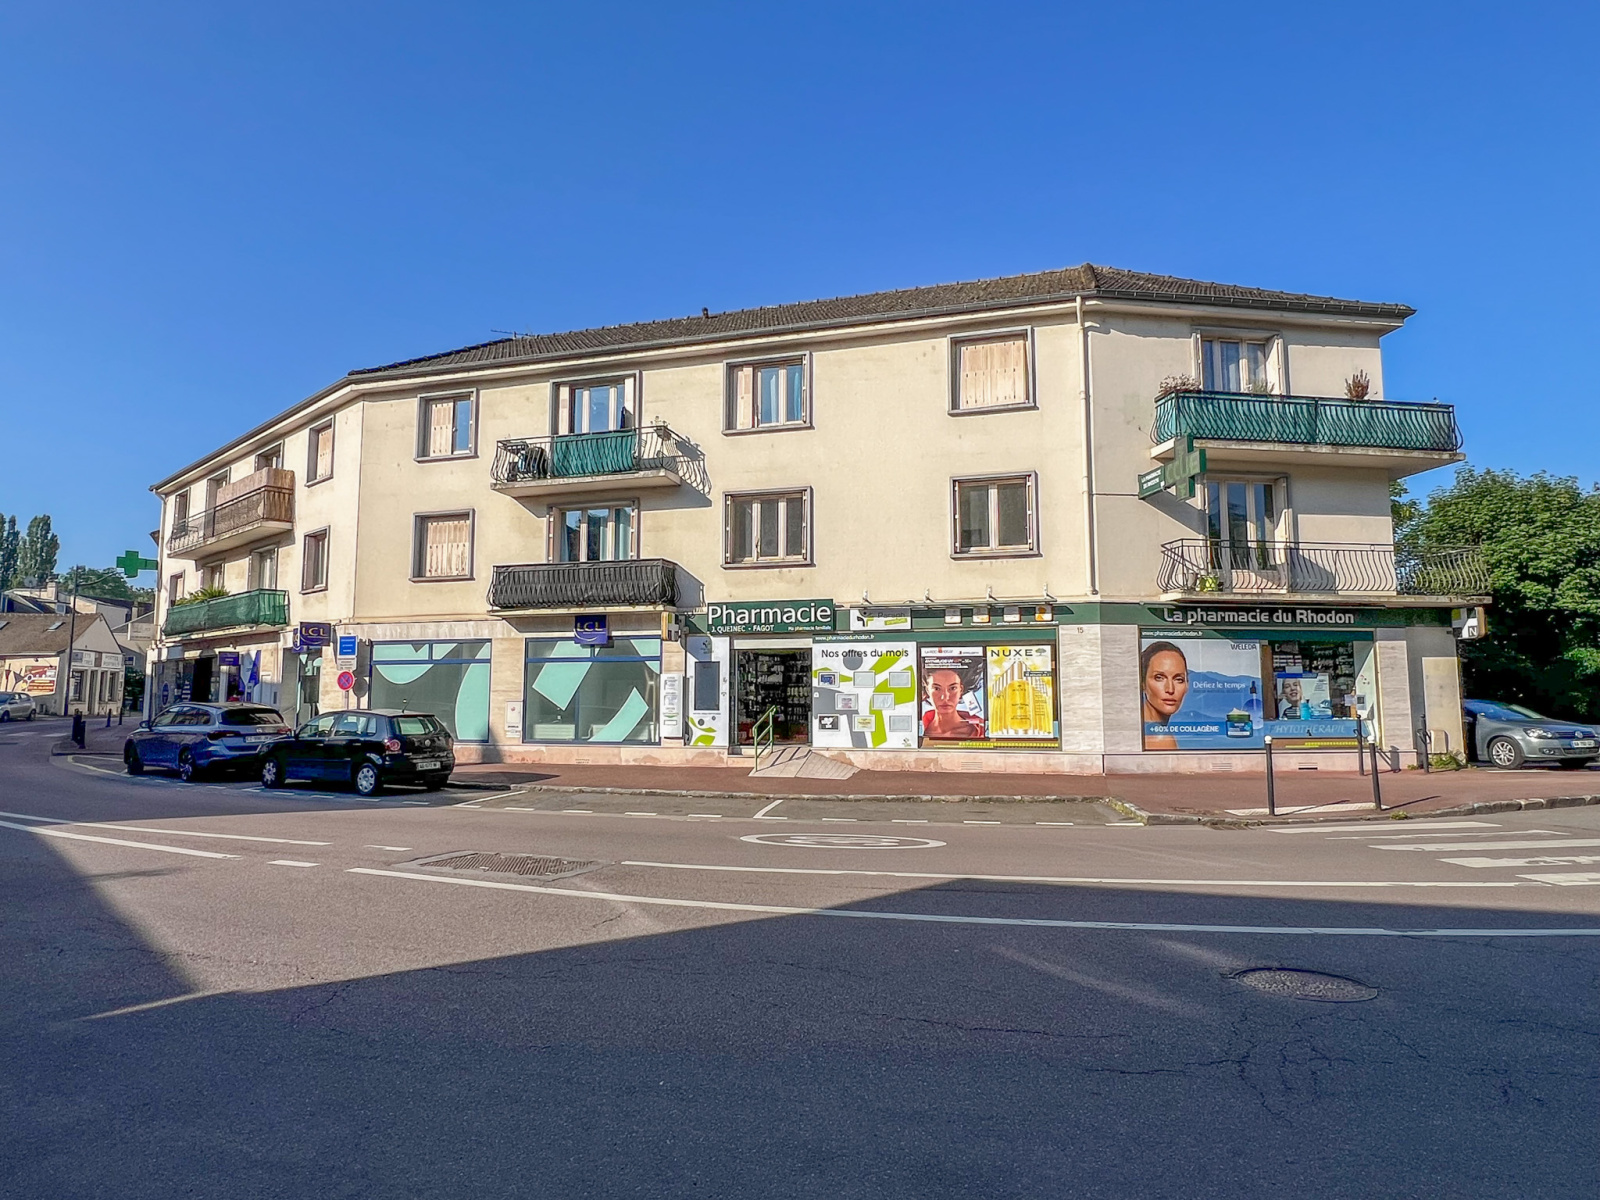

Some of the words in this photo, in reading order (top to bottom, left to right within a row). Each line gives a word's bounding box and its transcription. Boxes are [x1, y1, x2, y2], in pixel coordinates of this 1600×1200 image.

[708, 603, 831, 625] Pharmacie
[1163, 608, 1183, 622] La
[1187, 608, 1269, 625] pharmacie
[1272, 609, 1292, 623] du
[1296, 610, 1354, 624] Rhodon
[301, 627, 327, 636] LCL
[577, 622, 603, 632] LCL
[753, 624, 775, 632] FAGOT
[1230, 643, 1257, 651] WELEDA
[821, 649, 839, 658] Nos
[842, 649, 867, 658] offres
[870, 649, 882, 657] du
[885, 648, 909, 657] mois
[990, 649, 1033, 658] NUXE
[1225, 682, 1246, 690] temps
[1179, 724, 1219, 733] COLLAGÈNE
